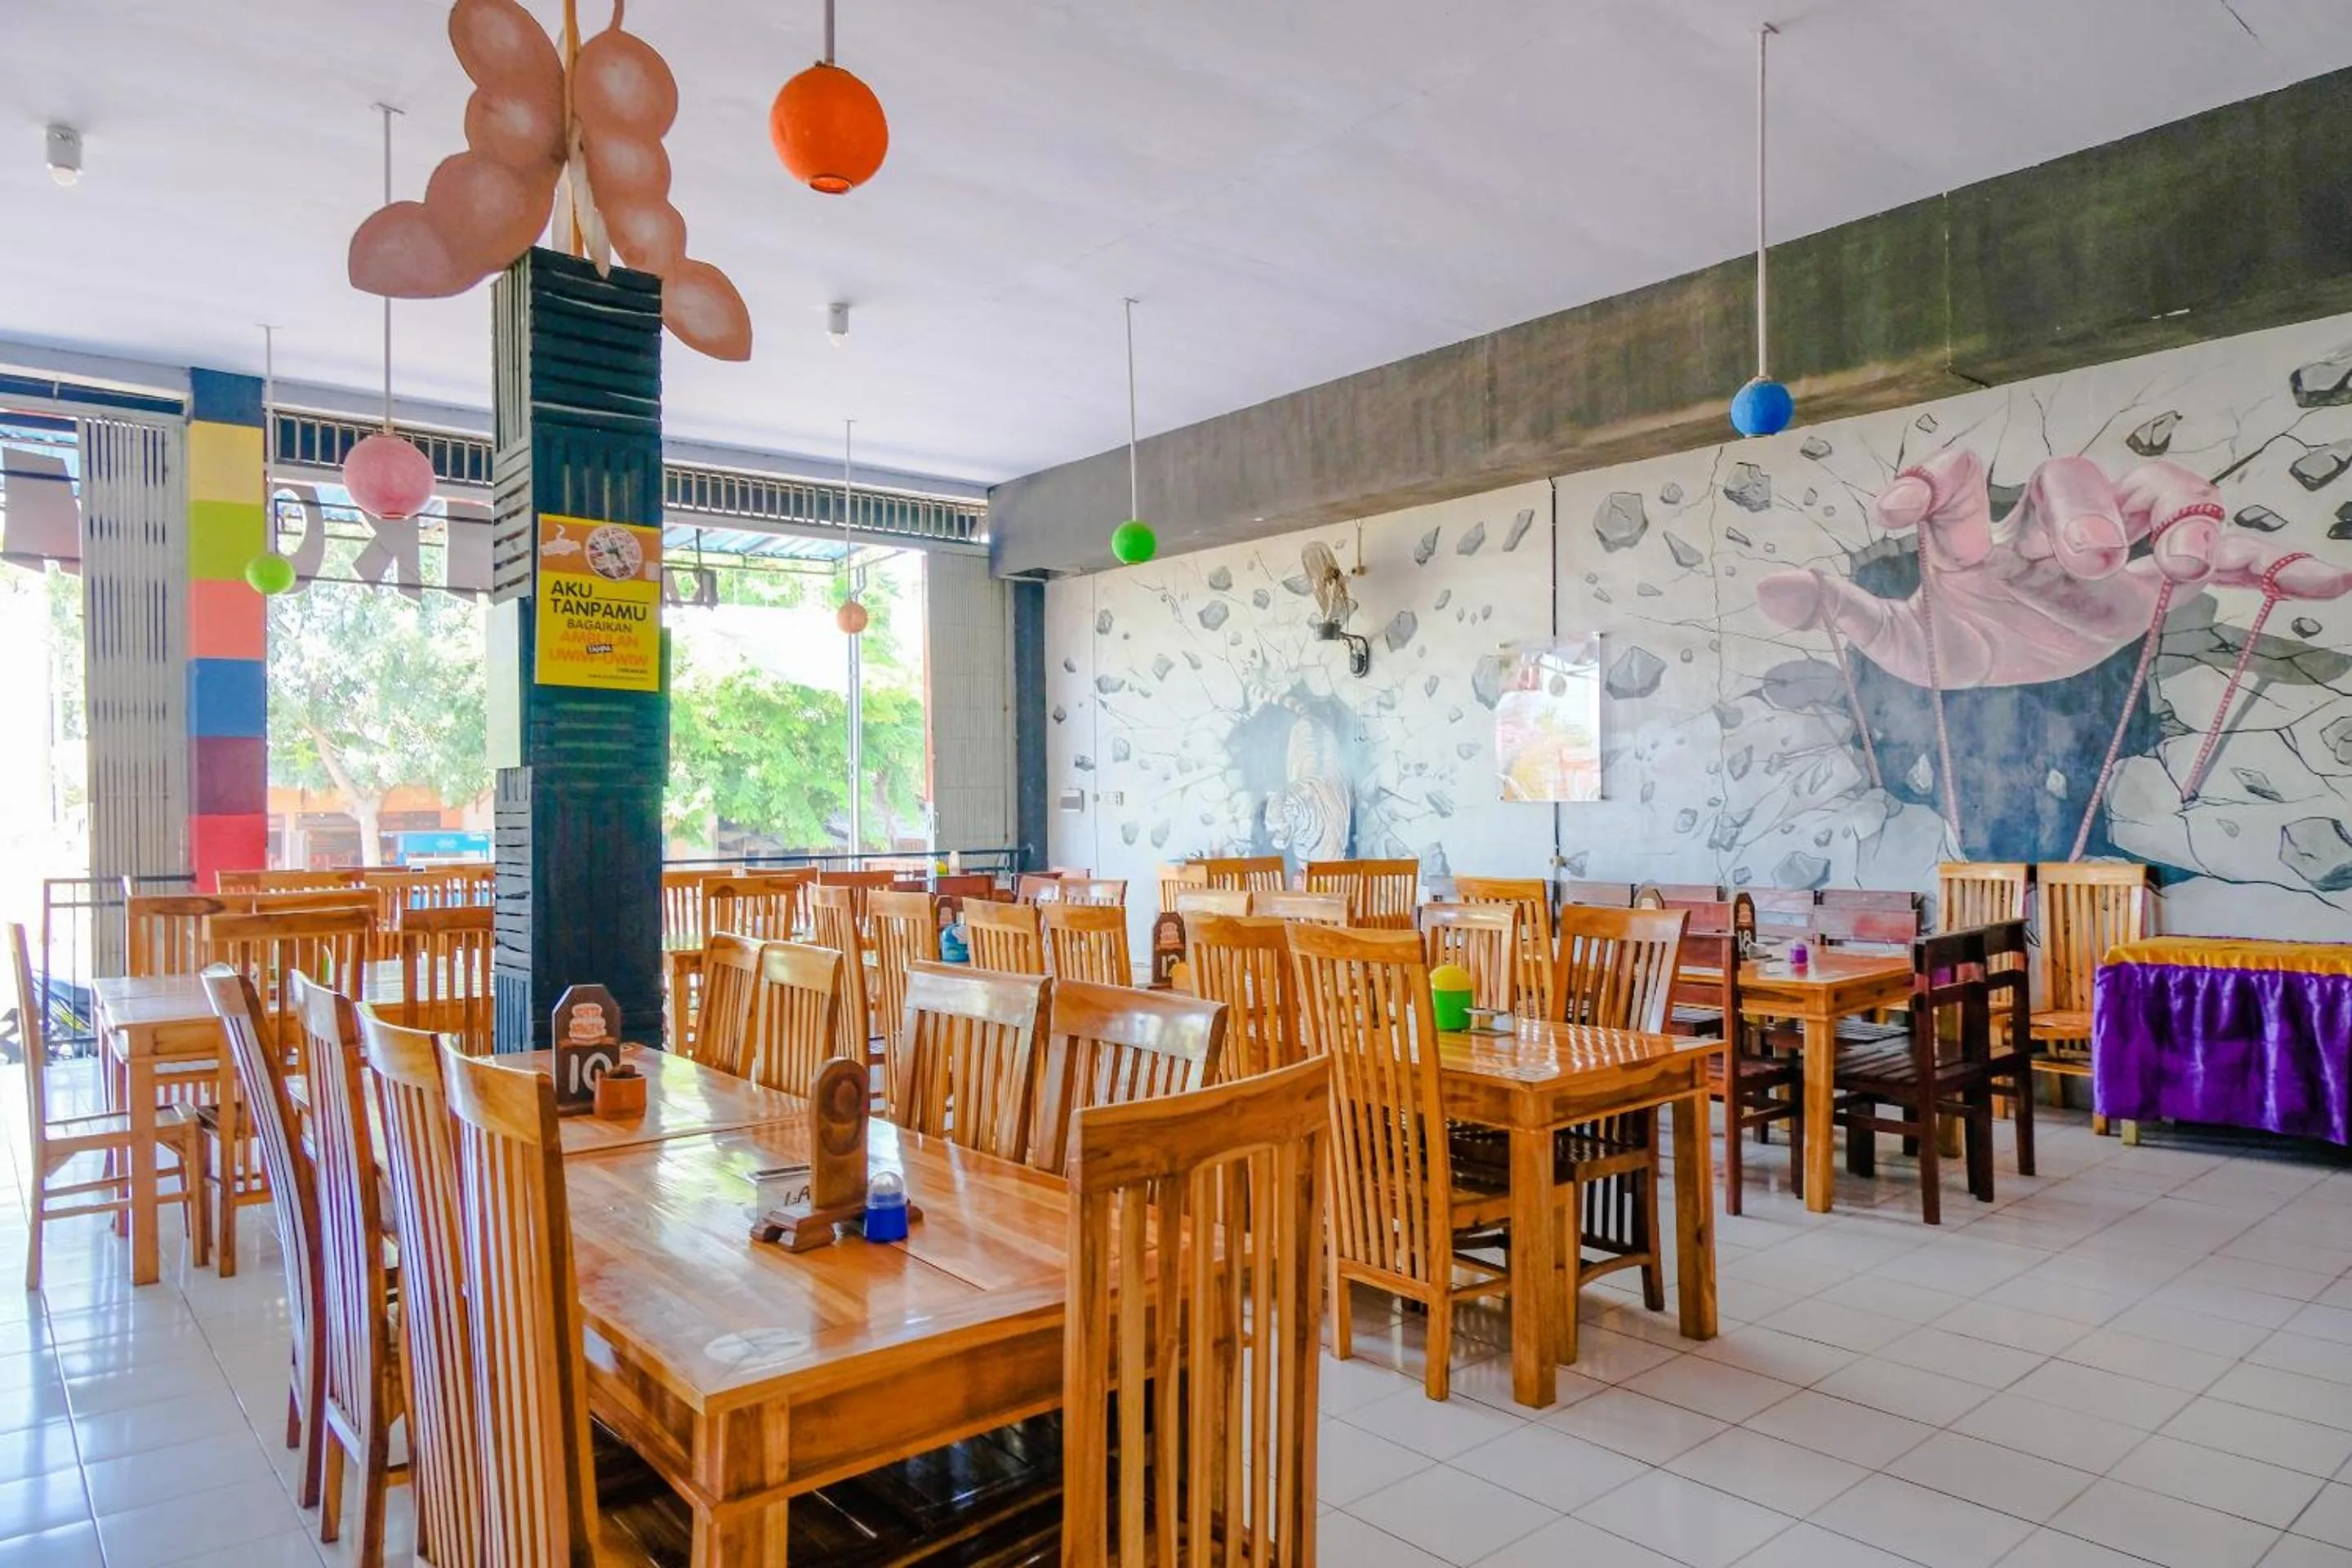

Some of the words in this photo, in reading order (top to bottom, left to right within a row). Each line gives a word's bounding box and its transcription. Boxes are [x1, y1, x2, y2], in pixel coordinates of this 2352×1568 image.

[551, 580, 593, 598] AKU
[550, 598, 647, 621] TANPAMU
[567, 618, 633, 633] BAGAIKAN
[569, 1052, 613, 1094] 10
